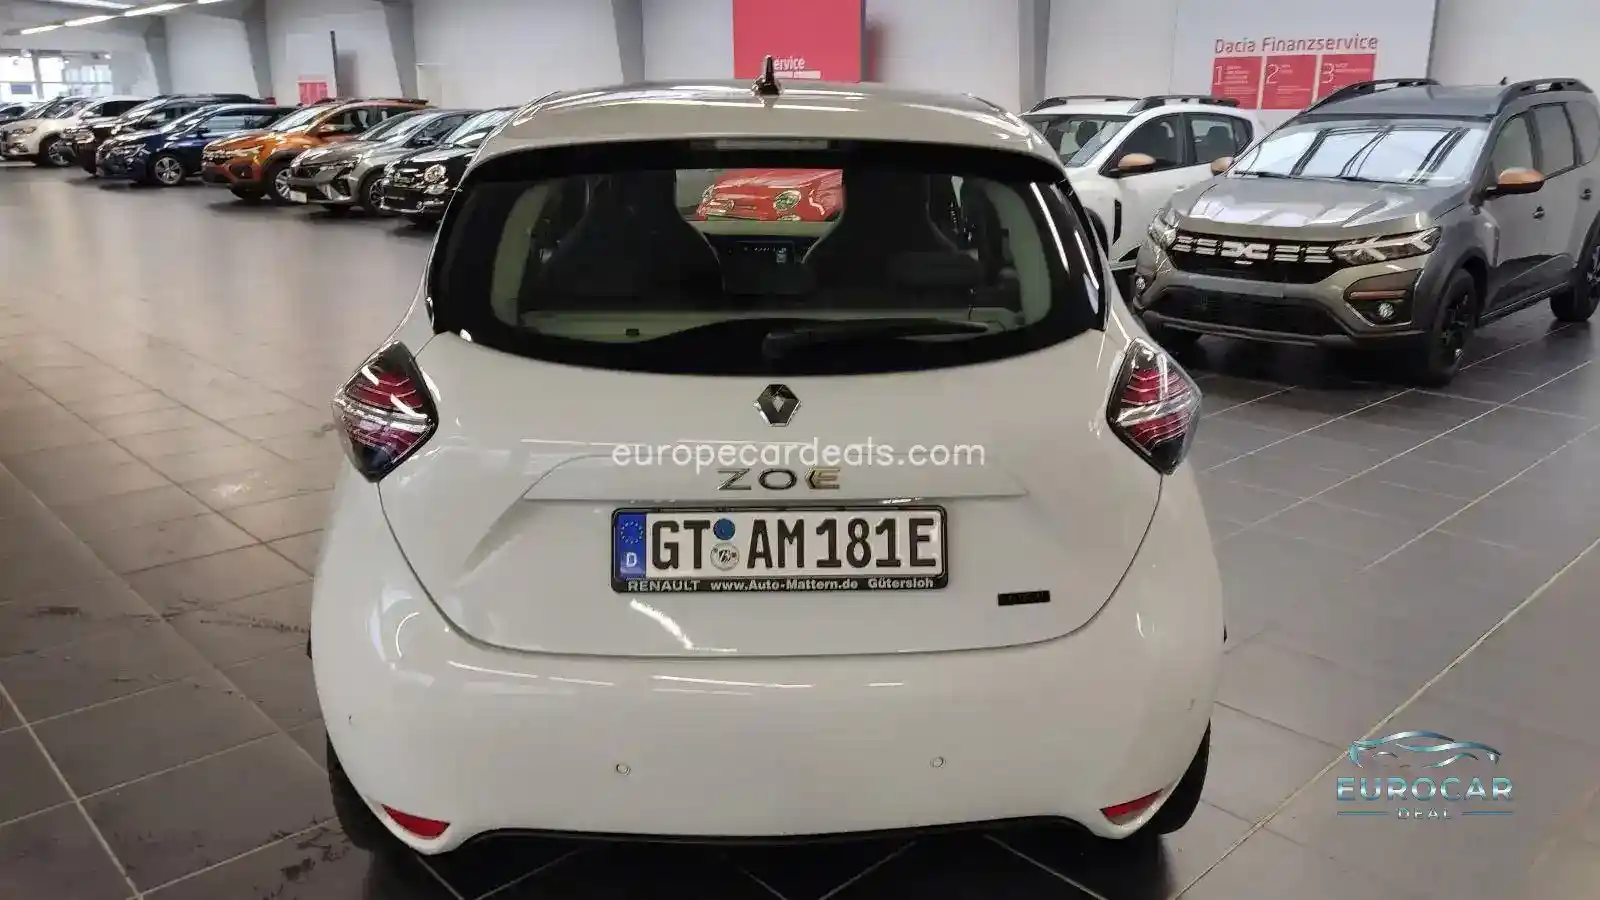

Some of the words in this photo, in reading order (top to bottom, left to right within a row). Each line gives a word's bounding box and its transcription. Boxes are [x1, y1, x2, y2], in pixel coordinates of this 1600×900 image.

[1214, 37, 1256, 54] Dacia
[1262, 33, 1379, 52] Finanzservice
[768, 56, 805, 70] ervice
[1321, 62, 1335, 84] 3
[1214, 65, 1223, 86] 1
[1266, 64, 1279, 84] 2
[717, 467, 841, 491] ZOE
[651, 519, 711, 571] GT
[625, 551, 638, 569] D
[627, 579, 701, 593] RENAULT
[710, 578, 859, 592] www.Auto-Mattern.de
[867, 577, 935, 591] Gütersloh
